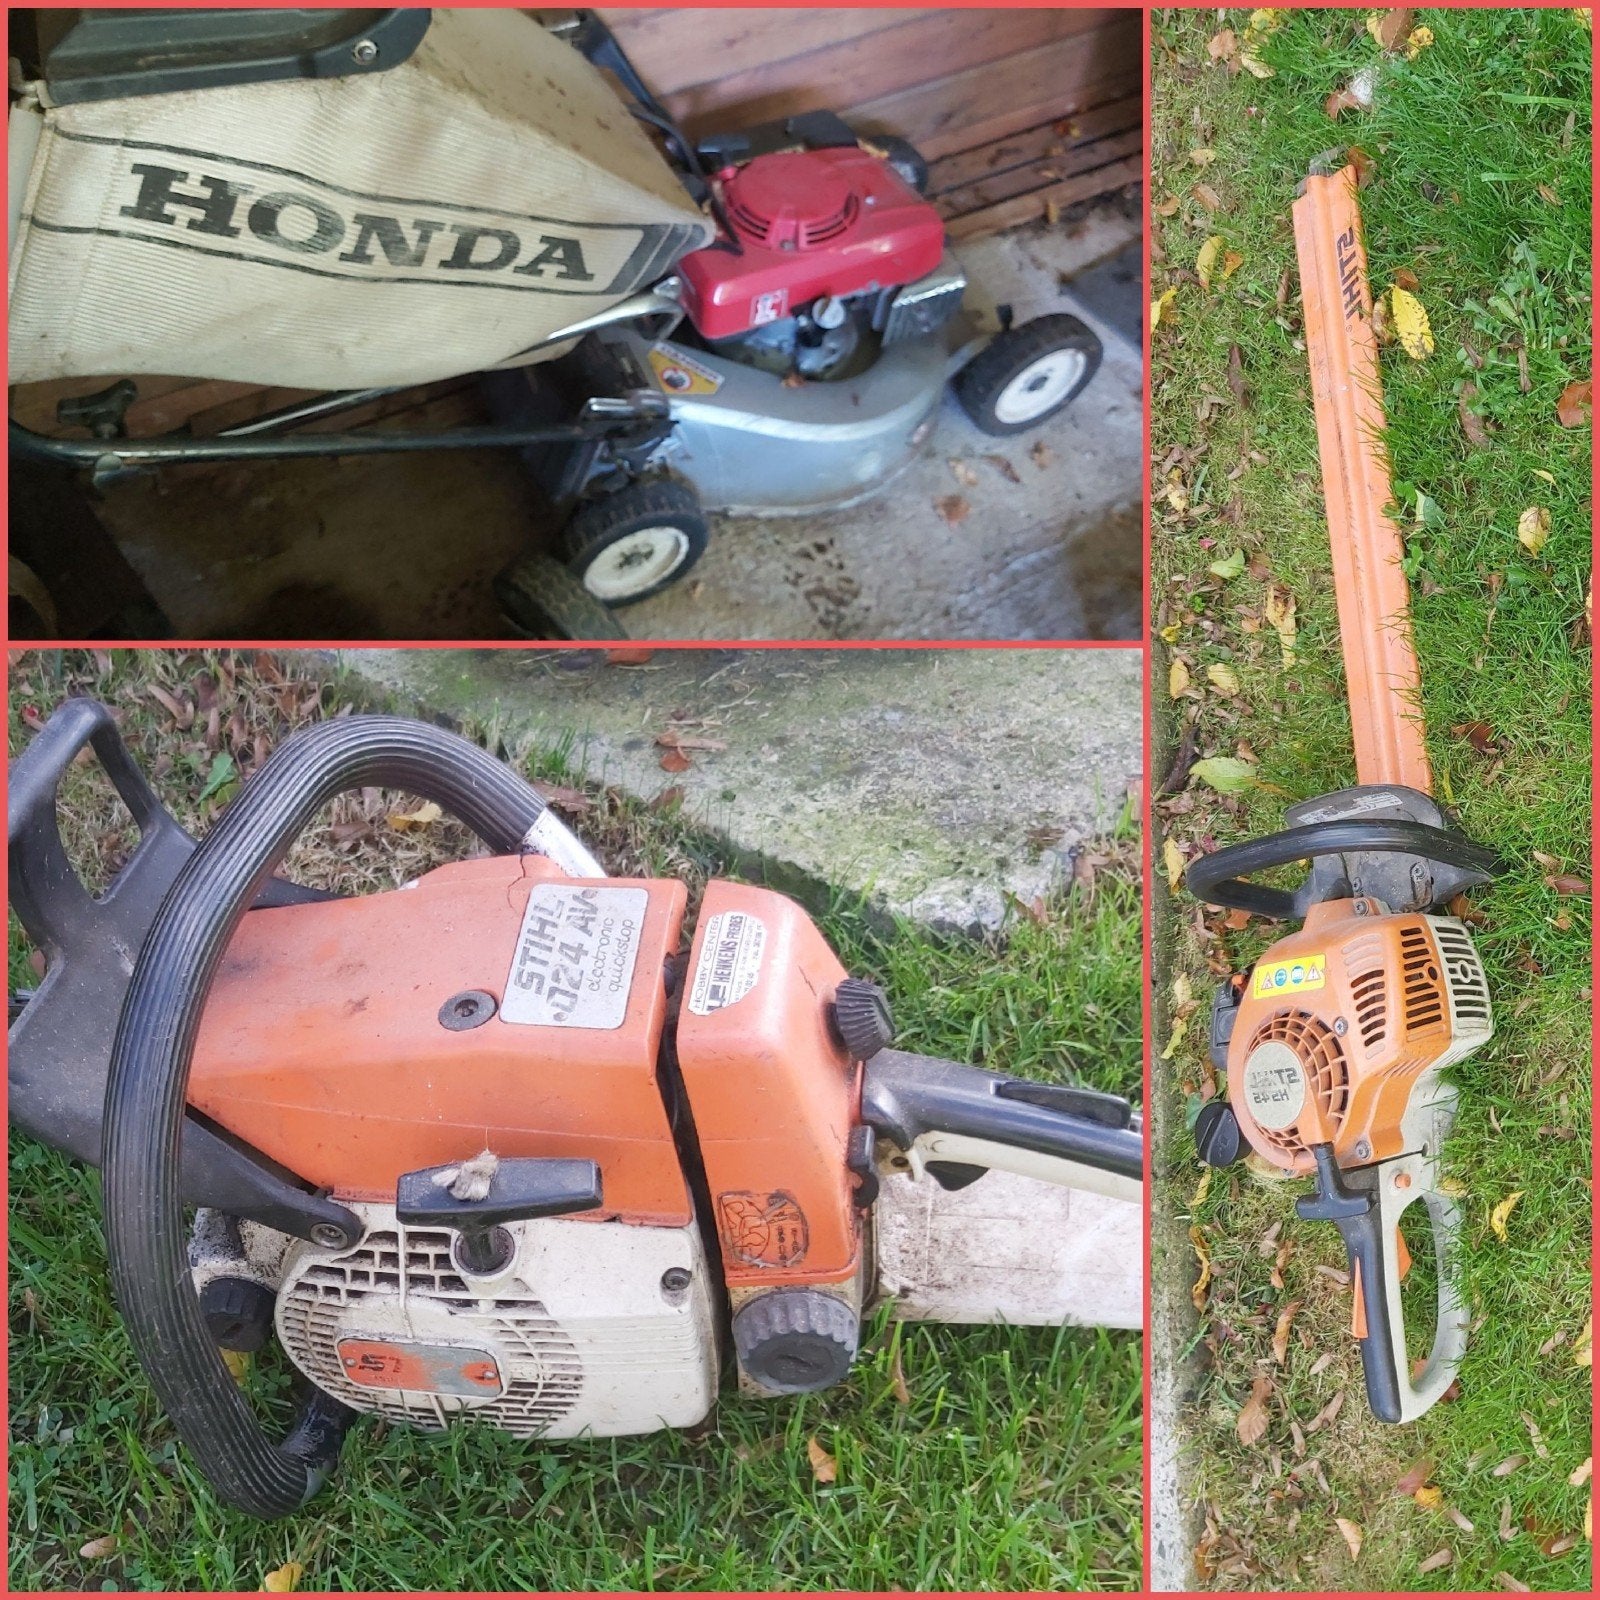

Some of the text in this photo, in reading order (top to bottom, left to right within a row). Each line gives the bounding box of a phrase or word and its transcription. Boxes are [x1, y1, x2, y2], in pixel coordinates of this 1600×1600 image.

[119, 163, 596, 282] HONDA
[514, 900, 565, 995] STIHL
[546, 893, 599, 1013] 024 AV
[588, 917, 615, 992] electronic
[608, 919, 635, 992] quickstop
[694, 915, 720, 1009] HOBBY CENTER
[712, 940, 738, 983] HENKENS
